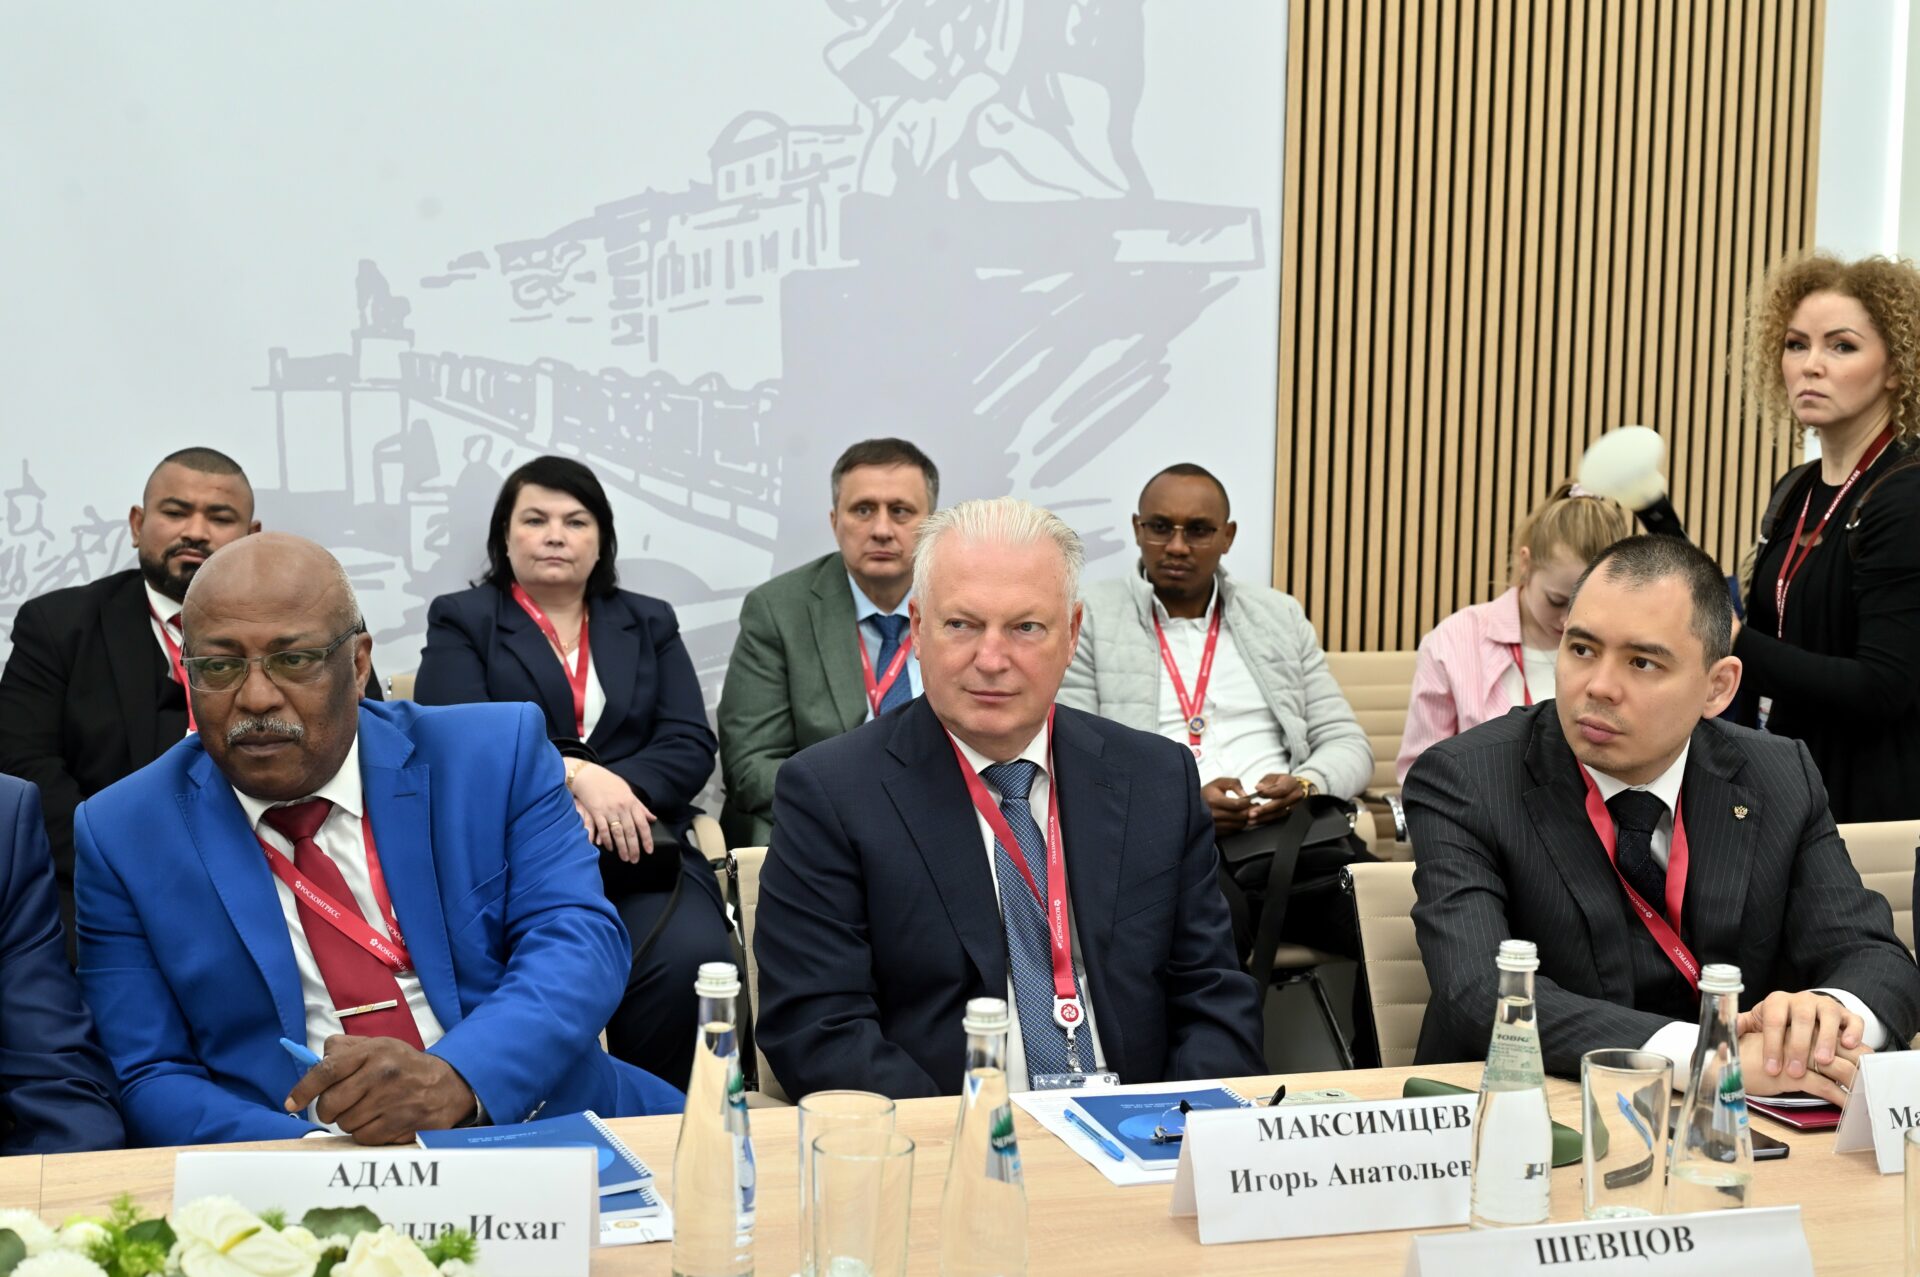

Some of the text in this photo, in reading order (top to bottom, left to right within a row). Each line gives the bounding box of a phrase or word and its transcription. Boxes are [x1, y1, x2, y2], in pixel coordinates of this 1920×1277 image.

[300, 885, 341, 919] РОСКОНГРЕСС
[1257, 1104, 1471, 1142] МАКСИМЦЕВ
[328, 1160, 440, 1192] АДАМ
[1229, 1168, 1318, 1197] Игорь
[469, 1214, 566, 1241] Исхаг
[1536, 1225, 1695, 1266] ШЕВЦОВ
